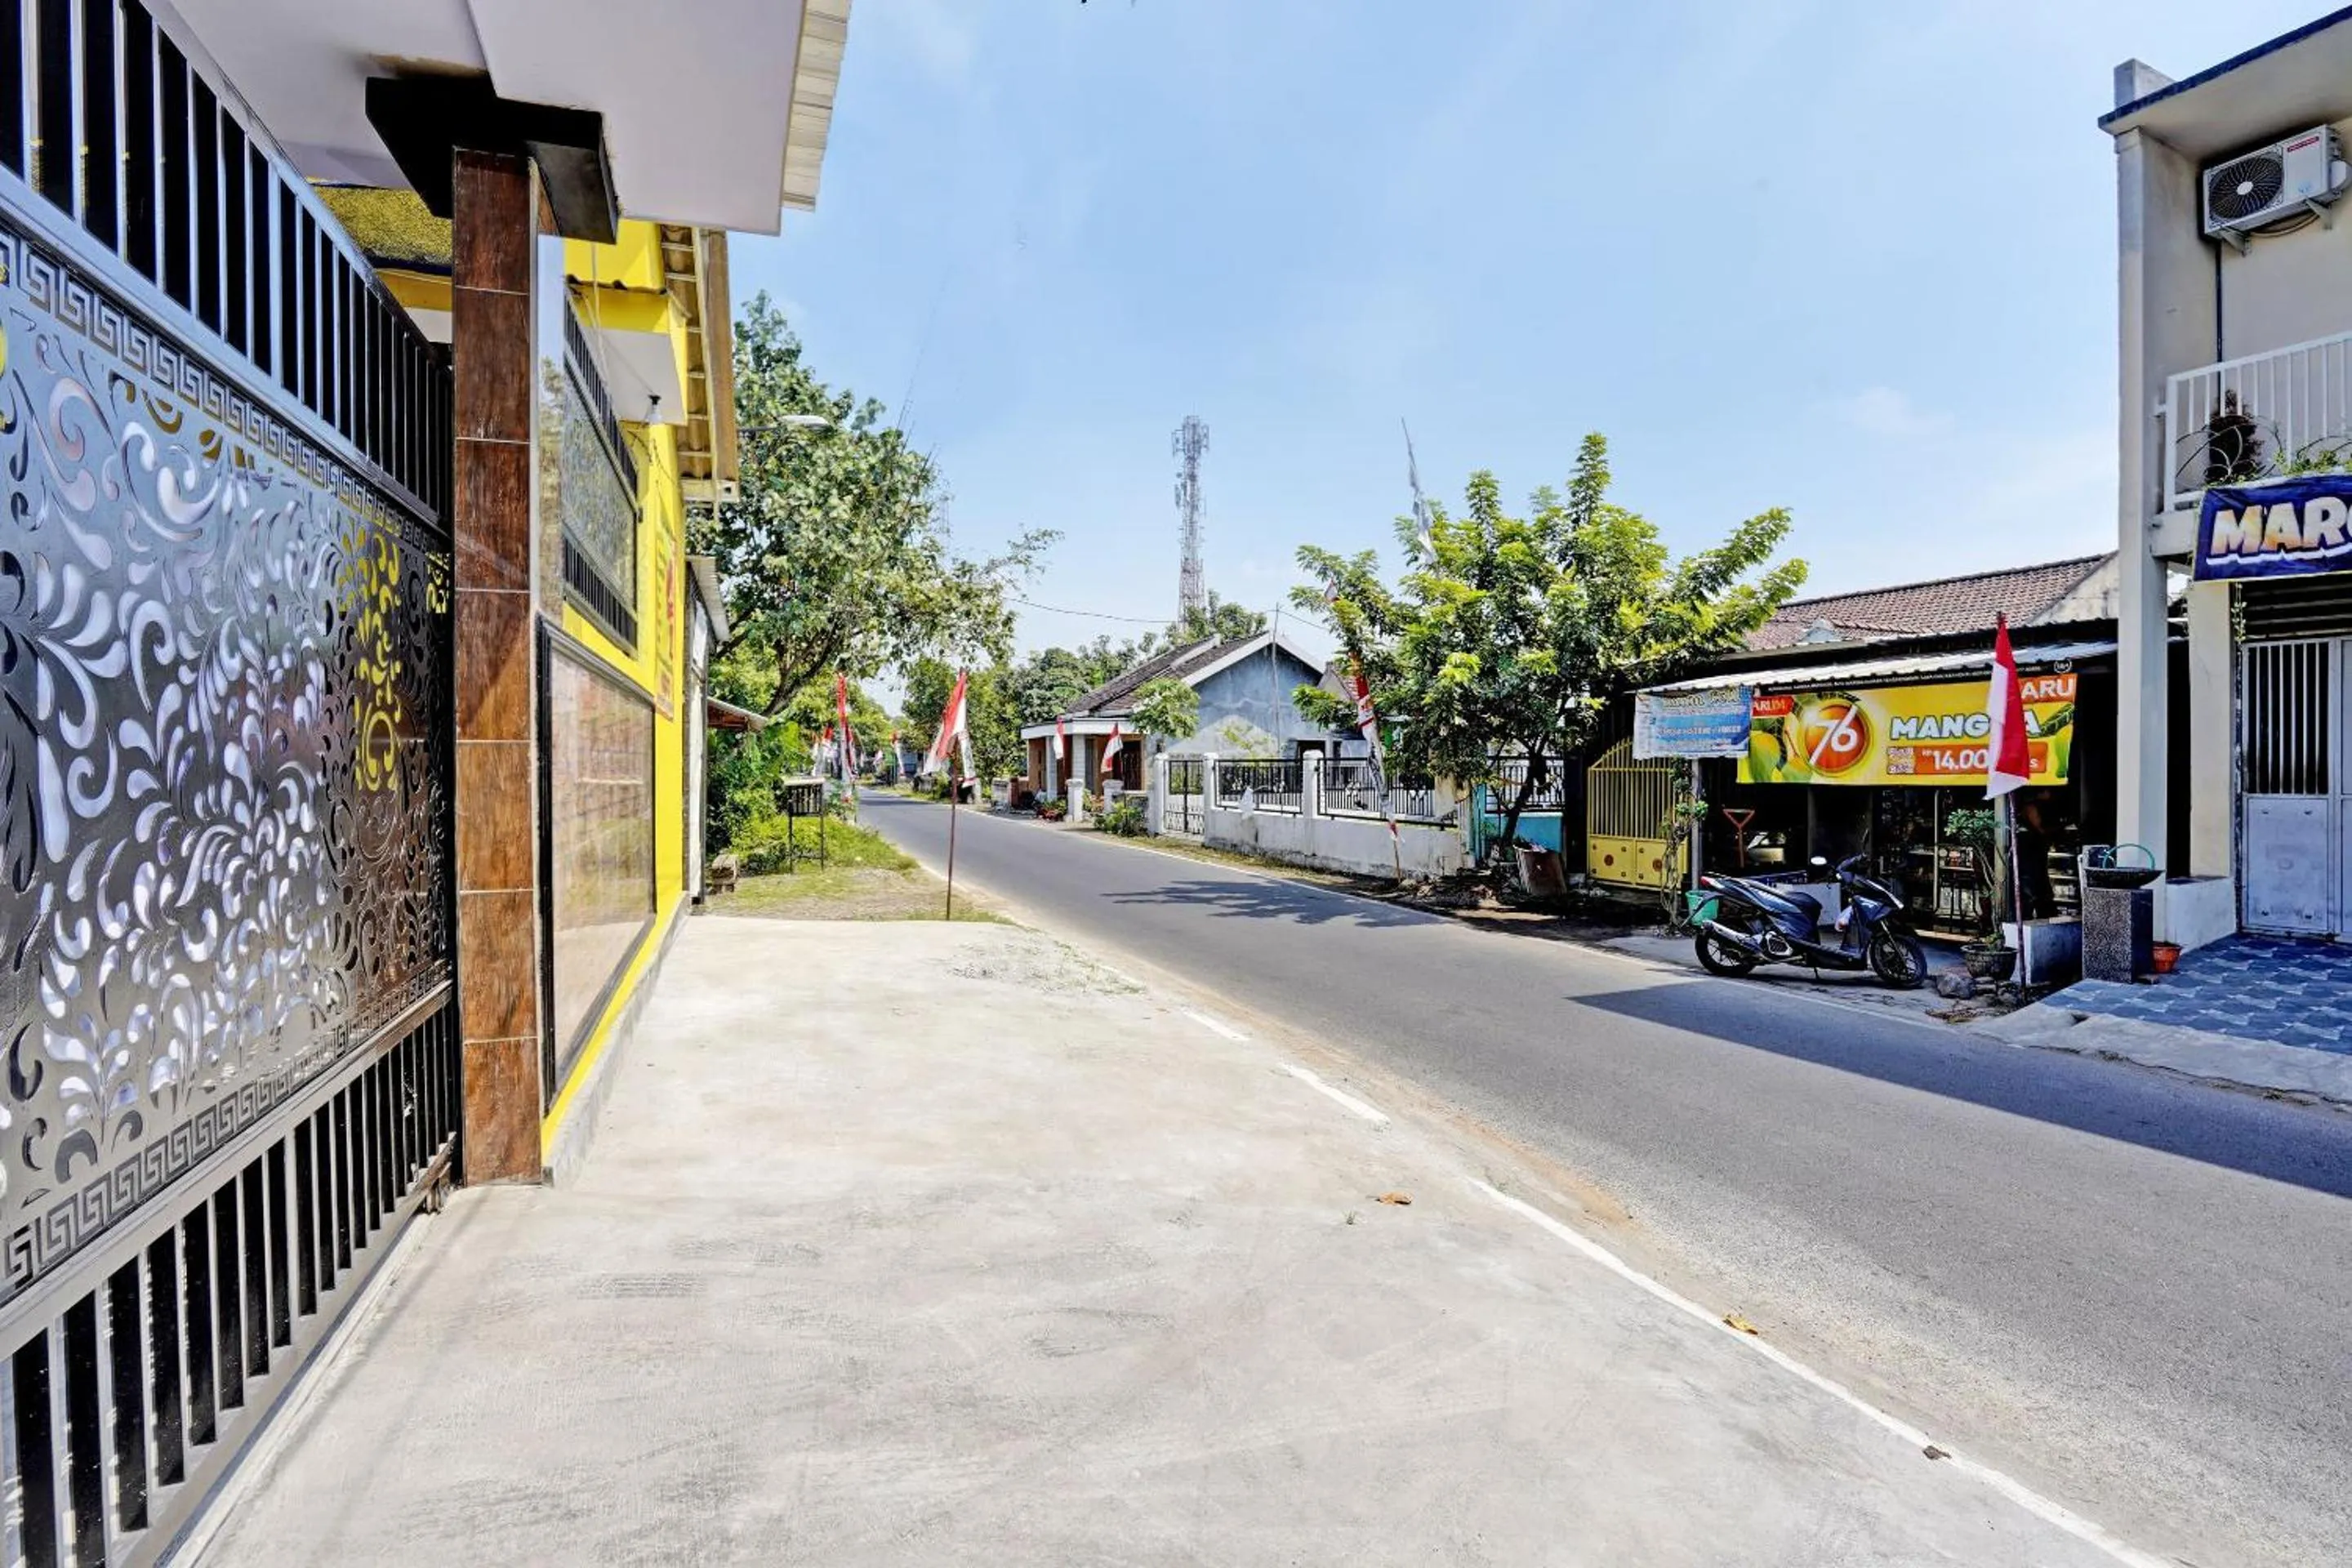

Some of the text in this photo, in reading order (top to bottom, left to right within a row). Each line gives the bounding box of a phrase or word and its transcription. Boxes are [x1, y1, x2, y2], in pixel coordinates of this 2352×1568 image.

[2211, 497, 2352, 555] MAR
[2021, 677, 2074, 699] ARU
[1810, 703, 1860, 765] 76
[1891, 708, 2042, 740] MANGA
[1932, 749, 1989, 771] 14.00
